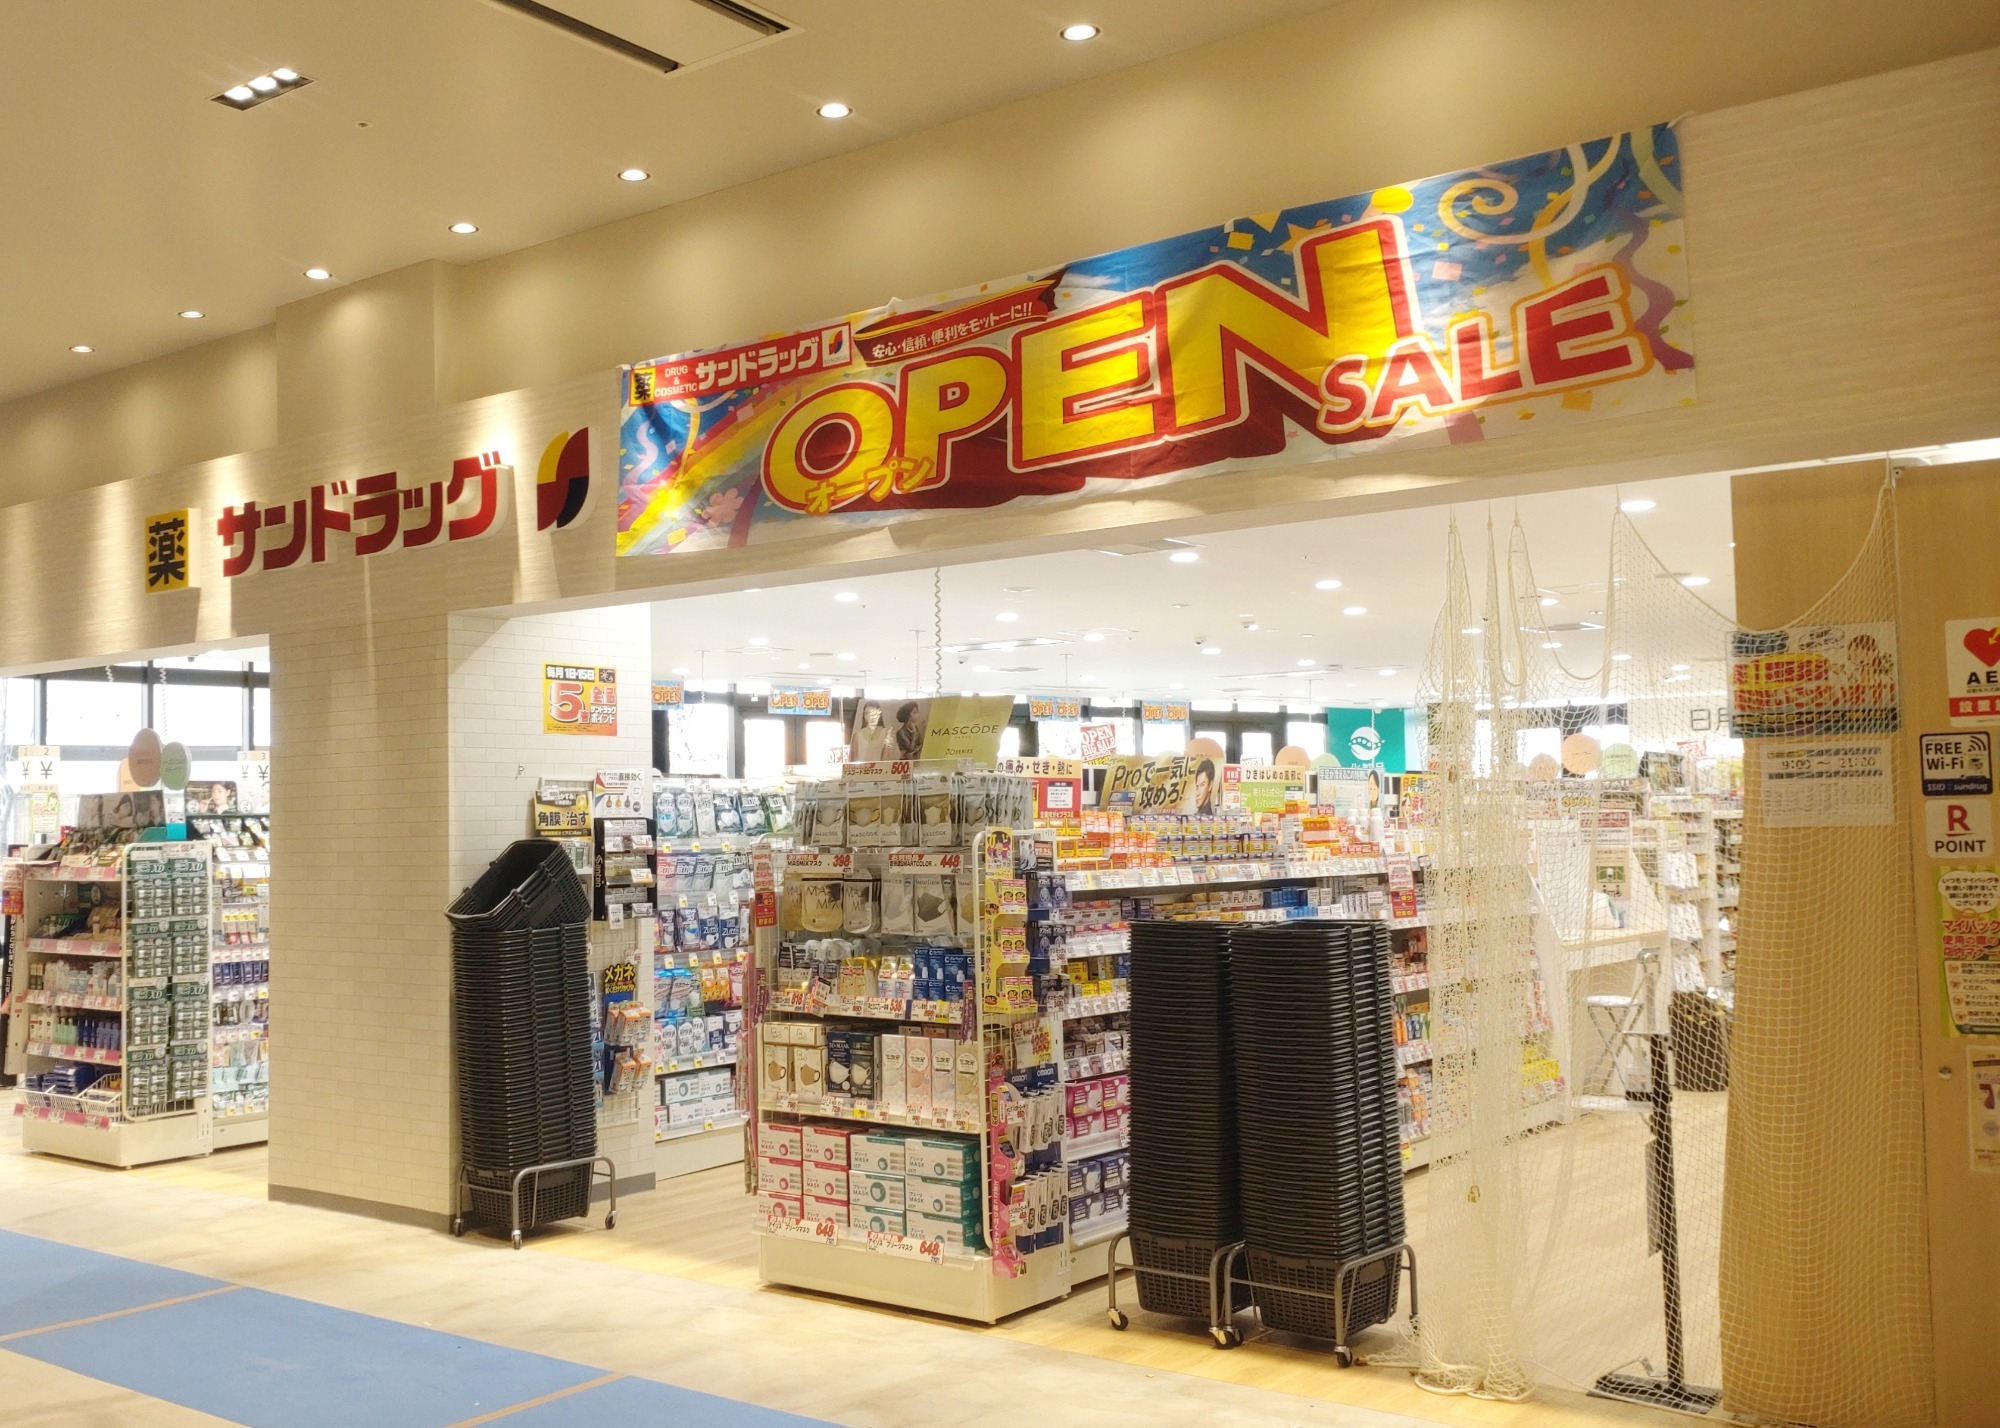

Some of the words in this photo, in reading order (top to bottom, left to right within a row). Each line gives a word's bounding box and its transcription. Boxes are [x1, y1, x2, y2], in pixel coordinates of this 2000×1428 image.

[1318, 270, 1642, 430] SALE
[664, 365, 689, 378] DRUG
[695, 336, 820, 391] サンドラッグ
[762, 219, 1405, 511] OPEN
[633, 371, 653, 401] 薬
[674, 376, 680, 385] &
[654, 382, 697, 398] COSMETIC
[805, 456, 936, 516] オープン
[217, 451, 501, 577] サンドラッグ
[147, 517, 187, 587] 薬
[591, 686, 616, 705] 全品
[653, 692, 682, 704] OPEN
[771, 694, 798, 708] OPEN
[802, 695, 830, 707] OPEN
[591, 713, 616, 725] ポイント
[1031, 705, 1054, 717] OPEN
[1057, 706, 1079, 717] OPEN
[1144, 708, 1163, 720] OPEN
[1167, 708, 1188, 720] OPEN
[1081, 725, 1113, 745] OPEN
[1081, 744, 1098, 756] BIG
[1096, 737, 1116, 752] SALE
[1925, 742, 1962, 755] FREE
[890, 761, 909, 774] 500
[1926, 757, 1964, 771] Wi-Fi
[1112, 756, 1197, 791] Proで一気に
[1138, 780, 1187, 810] 攻めろ!
[1927, 783, 1945, 791] SSID
[1953, 782, 1988, 793] sundrug
[538, 811, 561, 827] 角膜
[566, 811, 589, 826] 治す
[1947, 804, 1971, 832] R
[1935, 840, 1986, 853] POINT
[832, 855, 850, 868] 398
[939, 854, 960, 868] 448
[595, 854, 603, 888] Santen
[604, 963, 635, 983] メガネ
[815, 1222, 835, 1238] 648
[868, 1238, 883, 1247] アイリス
[919, 1240, 940, 1256] 648
